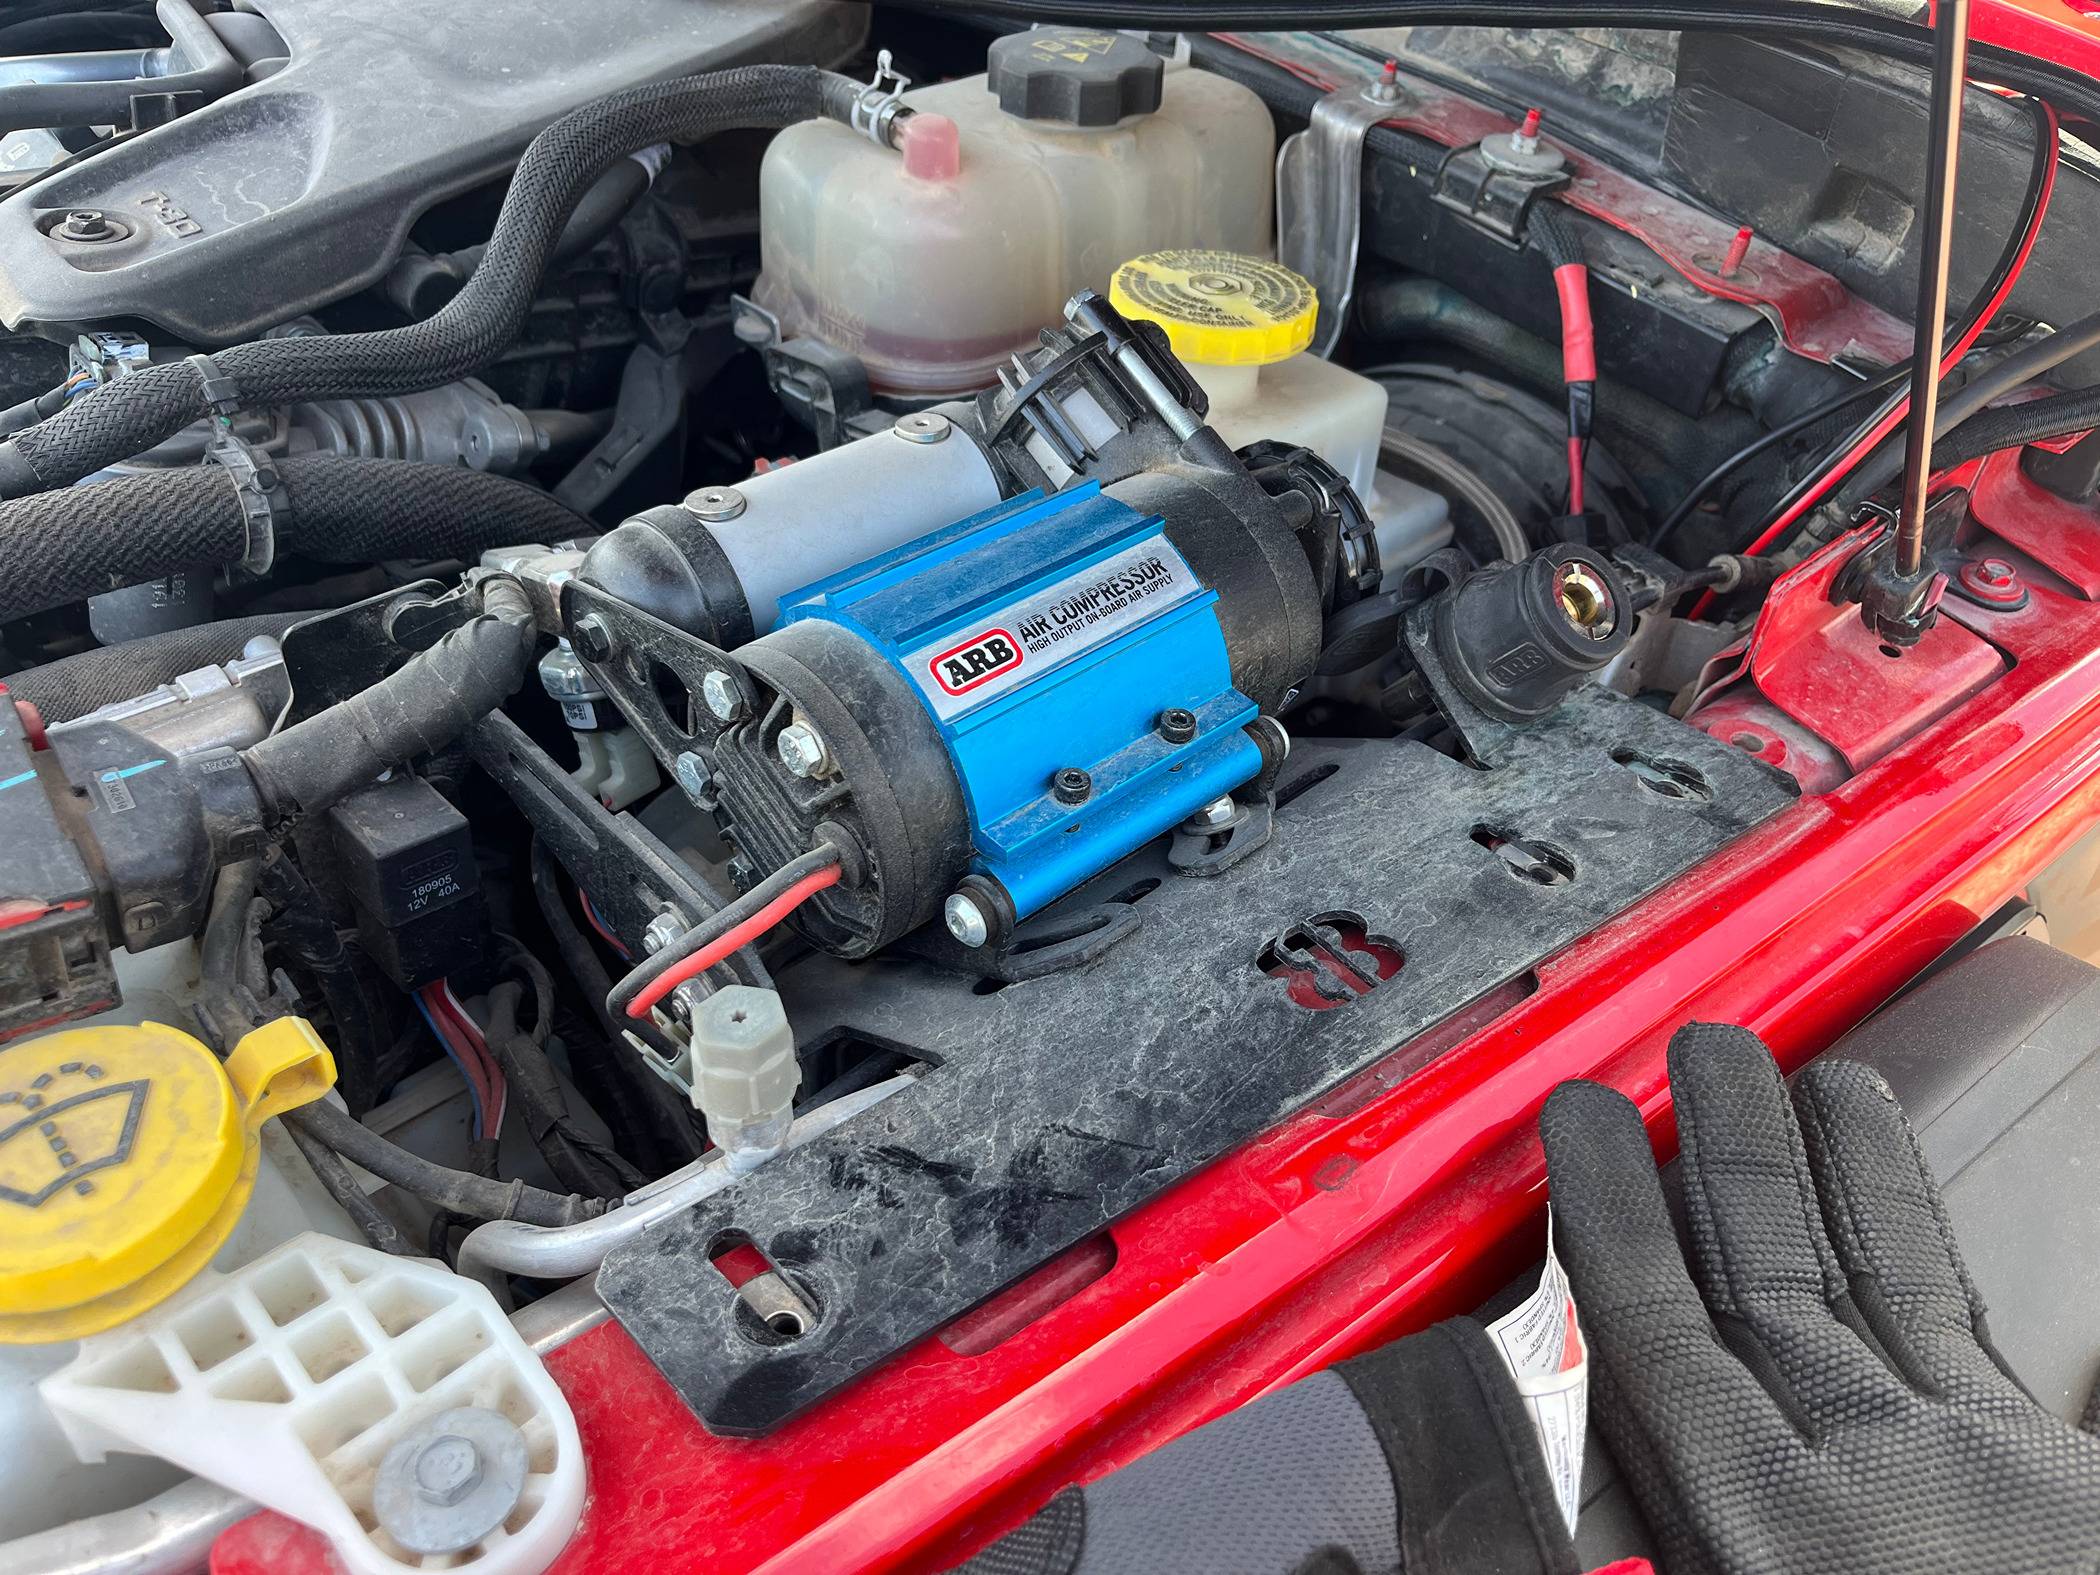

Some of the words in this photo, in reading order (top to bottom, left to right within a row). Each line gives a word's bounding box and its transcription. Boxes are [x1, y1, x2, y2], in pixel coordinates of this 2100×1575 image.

[1017, 613, 1053, 643] AIR
[1049, 556, 1168, 625] COMPRESSOR
[1027, 635, 1052, 654] HIGH
[1053, 618, 1087, 642] OUTPUT
[1086, 597, 1128, 625] ON-BOARD
[1128, 590, 1144, 604] AIR
[1145, 574, 1174, 596] SUPPLY
[943, 638, 1014, 688] ARB
[407, 895, 429, 912] 12V
[438, 882, 461, 898] 40A
[412, 874, 452, 899] 180905
